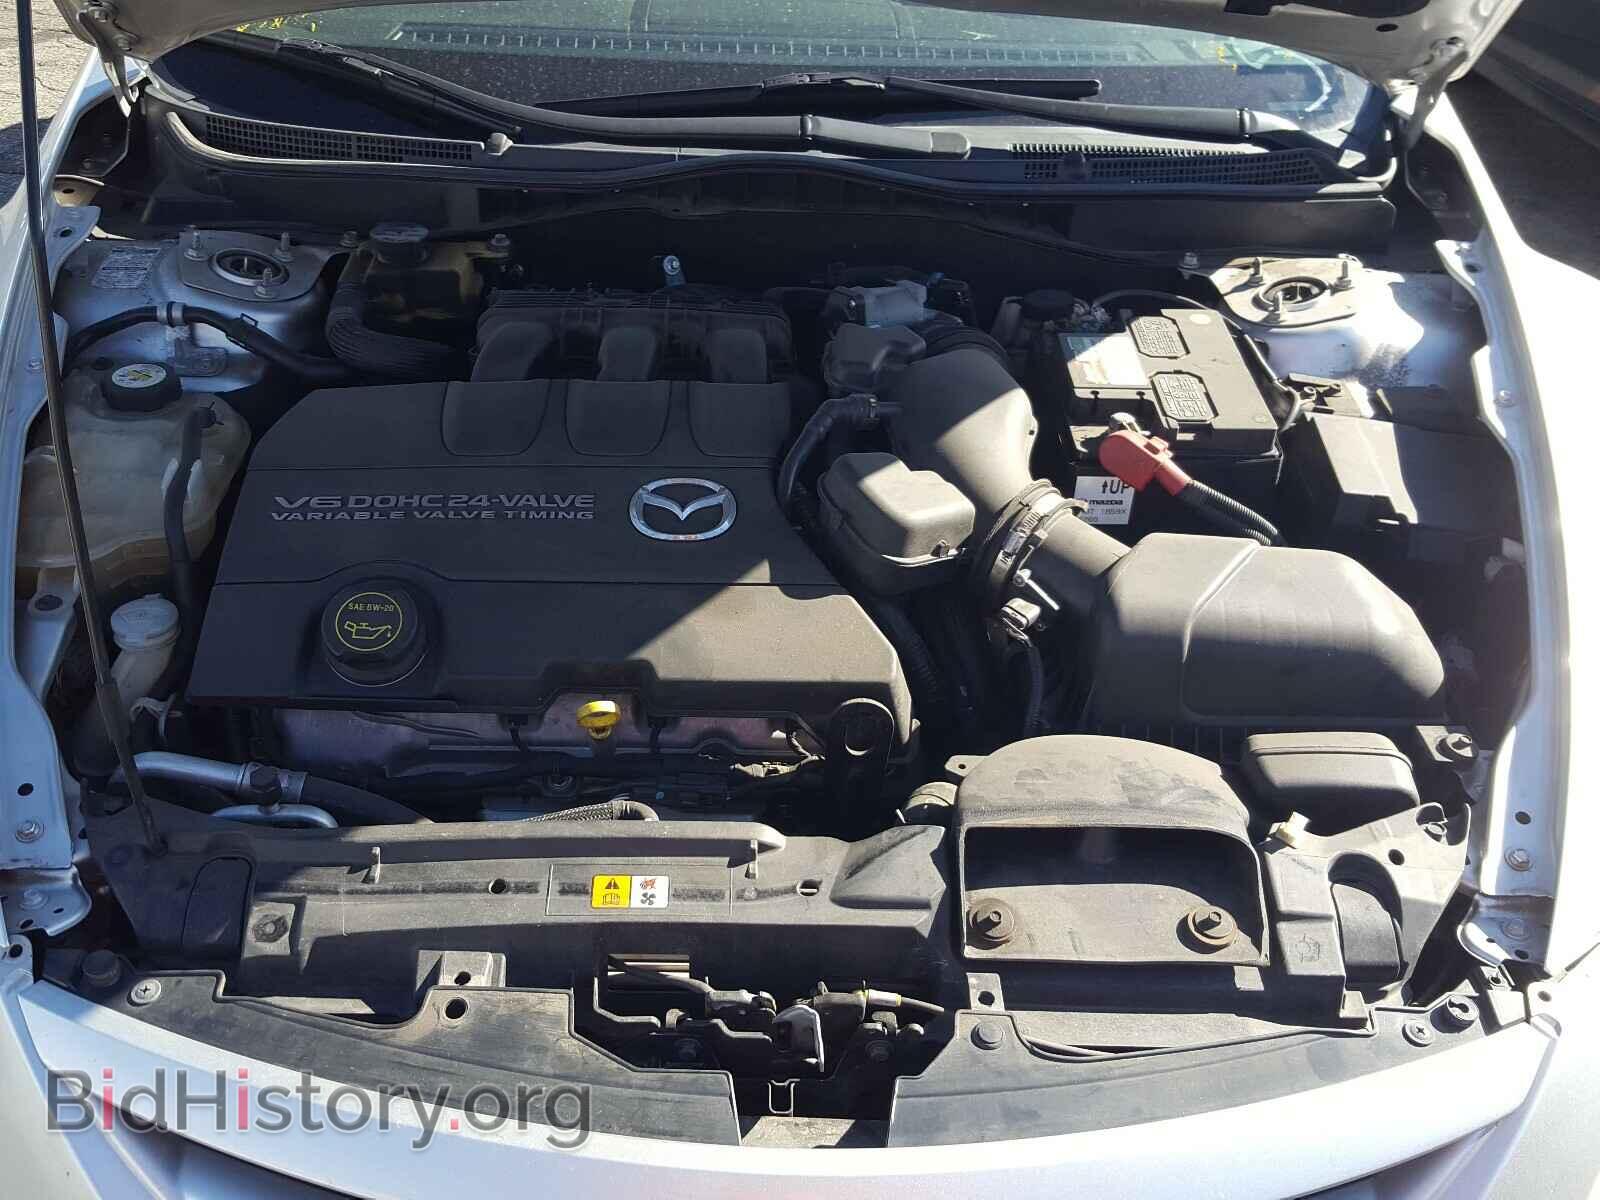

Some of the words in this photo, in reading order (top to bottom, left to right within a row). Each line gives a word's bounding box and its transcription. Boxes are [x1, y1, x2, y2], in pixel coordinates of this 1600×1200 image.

[1109, 479, 1129, 494] UP
[274, 496, 342, 508] V6
[347, 494, 444, 508] DOHC
[447, 494, 595, 508] 24-VALVE
[271, 511, 406, 521] VARIABLE
[413, 510, 497, 519] VALVE
[504, 510, 594, 520] TIMING
[348, 603, 367, 611] SAE
